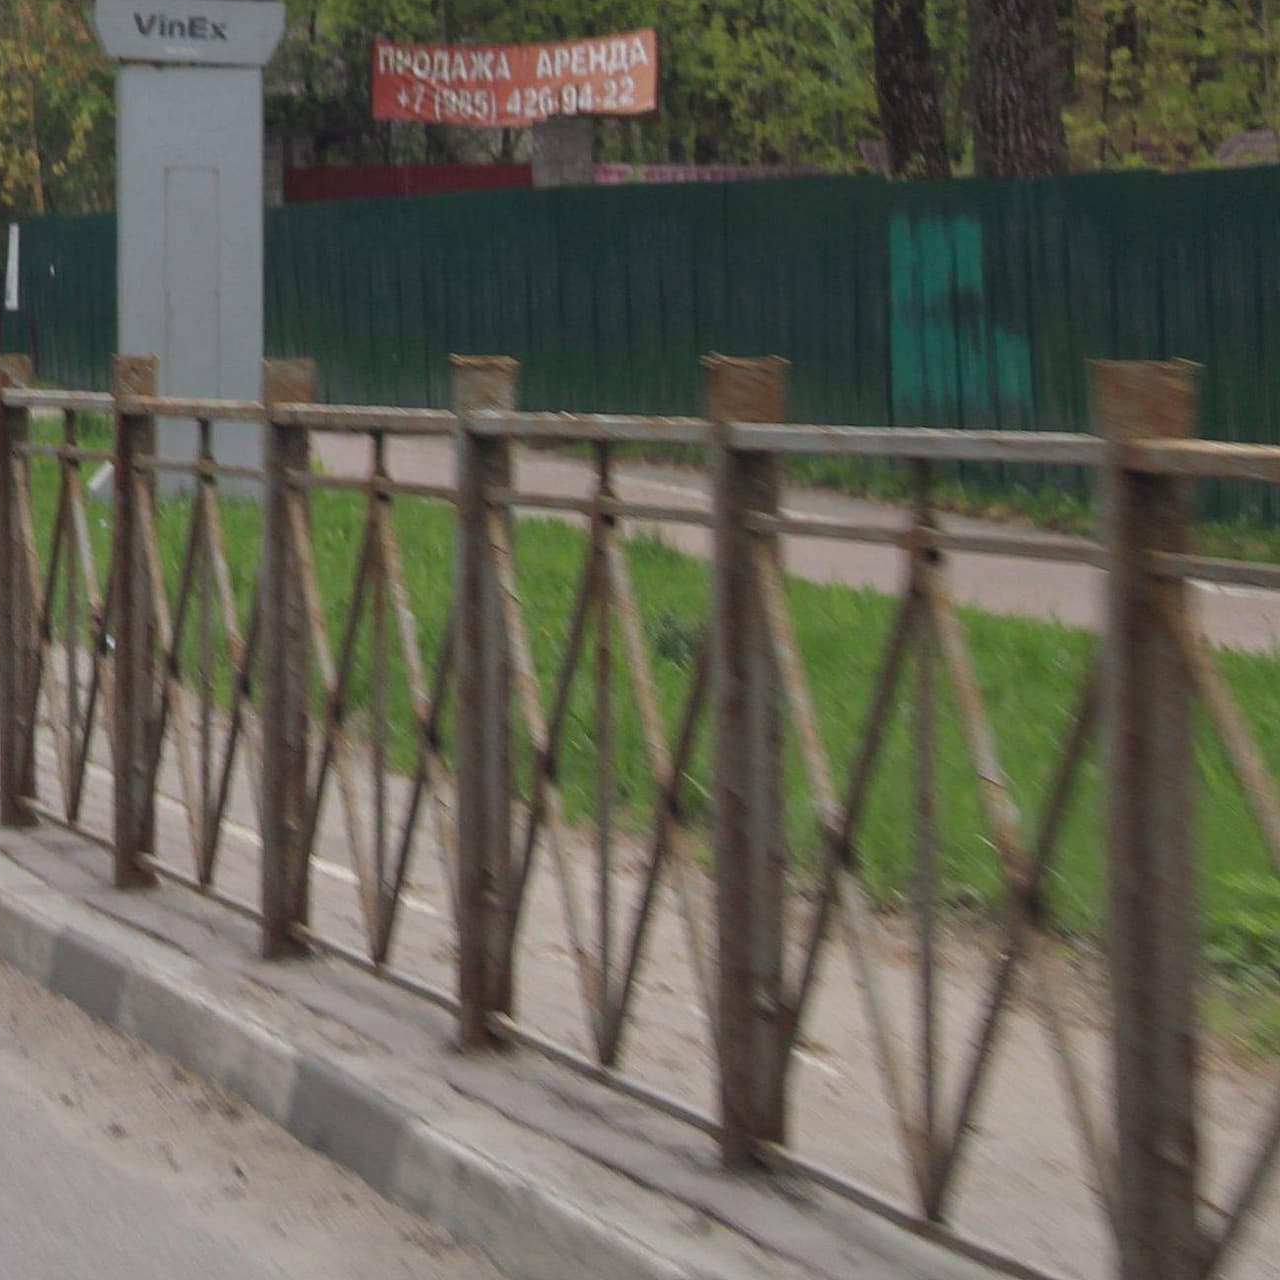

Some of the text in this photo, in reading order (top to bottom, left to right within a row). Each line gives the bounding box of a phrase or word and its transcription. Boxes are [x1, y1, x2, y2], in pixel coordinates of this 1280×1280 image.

[133, 11, 228, 41] VinEx
[377, 37, 650, 82] ПРОДАЖА АРЕНДА
